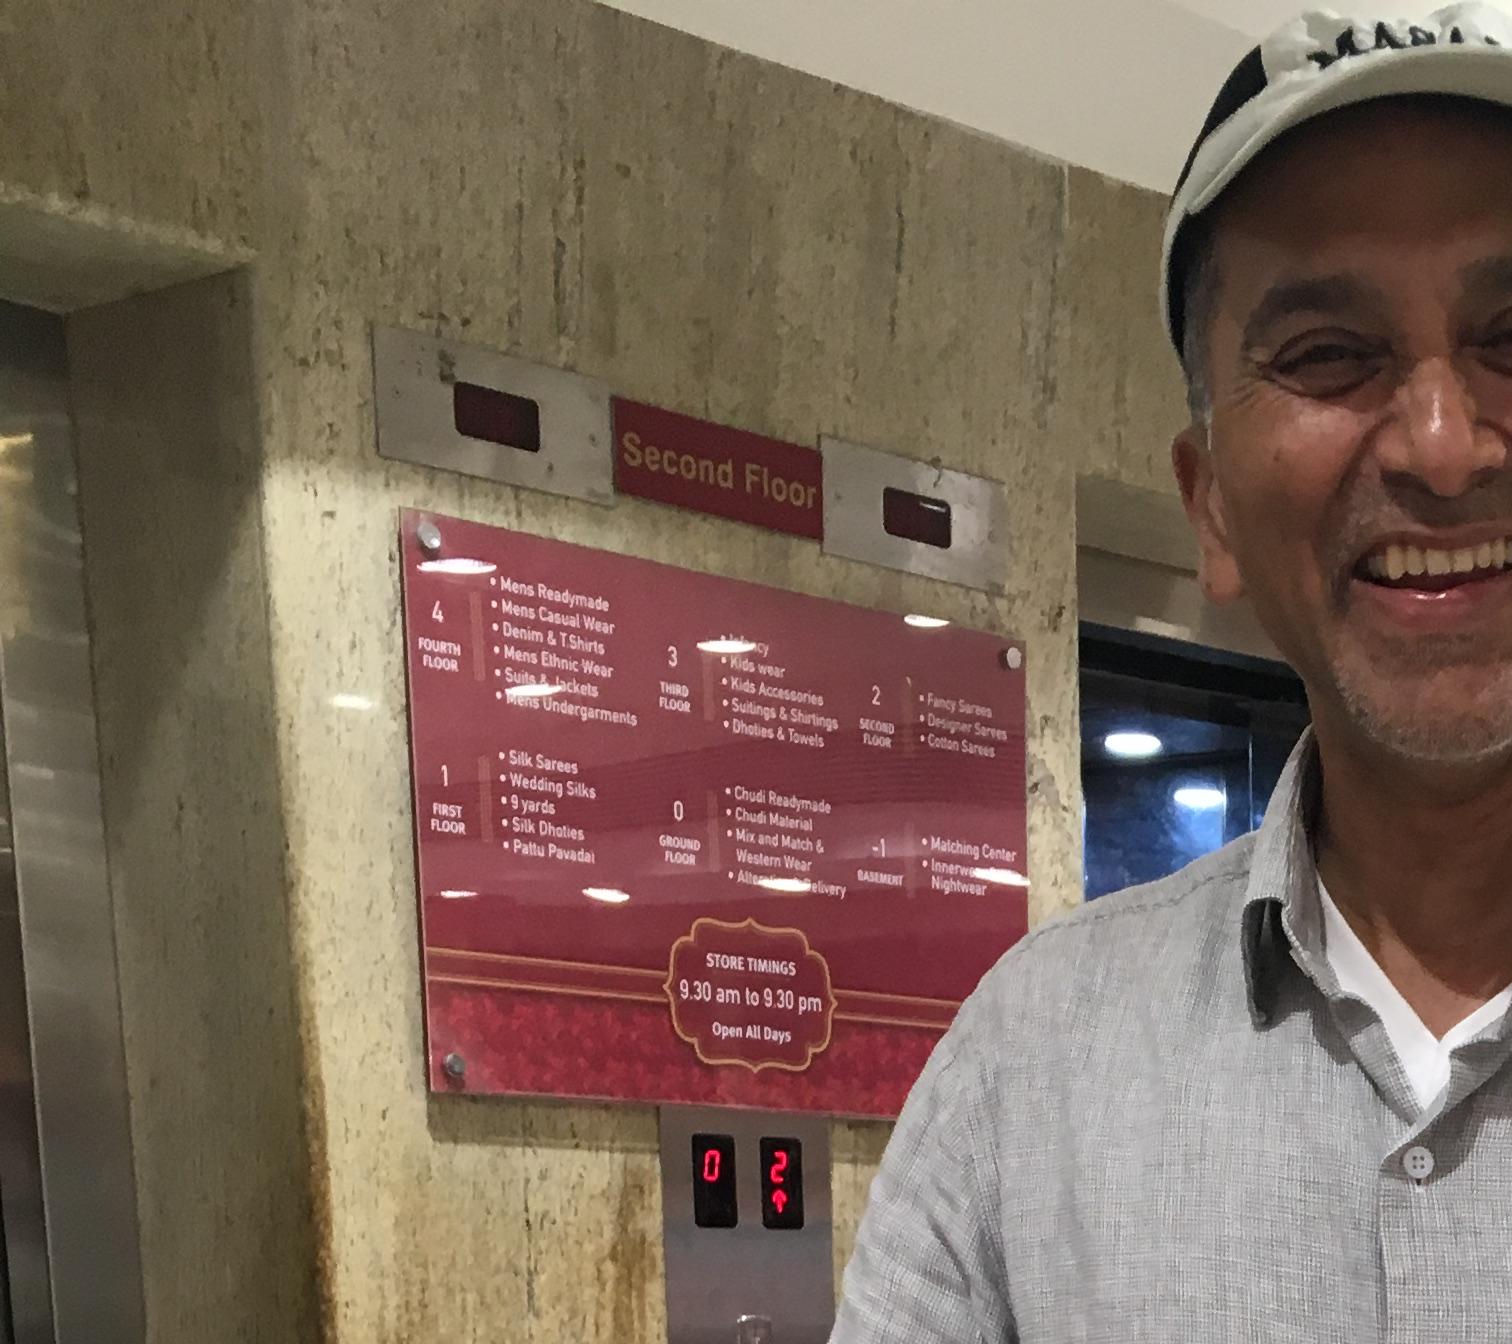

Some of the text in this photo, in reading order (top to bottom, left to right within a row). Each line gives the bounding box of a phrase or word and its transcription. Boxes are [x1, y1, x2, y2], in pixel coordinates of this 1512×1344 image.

[623, 432, 816, 509] Second Floor
[500, 576, 609, 611] Mens Readymade
[432, 600, 444, 622] 4
[501, 600, 615, 634] Mens Casual Wear
[503, 622, 543, 643] Denim
[547, 631, 557, 646] &
[418, 637, 461, 656] FOURTH
[667, 645, 678, 667] 3
[423, 655, 459, 672] FLOOR
[504, 645, 614, 678] Mens Ethnic Wear
[731, 656, 786, 679] Kids wear
[505, 667, 536, 685] Suits
[554, 676, 599, 698] Jackets
[660, 681, 689, 697] THIRD
[731, 677, 824, 706] Kids Accessories
[659, 697, 691, 713] FLOOR
[872, 685, 880, 705] 2
[928, 692, 992, 718] Fancy Sarees
[543, 697, 638, 726] Undergarments
[732, 698, 838, 732] Suitings & Shirtings
[733, 719, 825, 748] Dhoties & Towels
[859, 717, 895, 735] SECOND
[974, 722, 1007, 741] Sarees
[863, 732, 892, 748] FLOOR
[928, 733, 995, 758] Cotton Sarees
[509, 750, 578, 774] Silk Sarees
[441, 765, 448, 787] 1
[510, 772, 596, 799] Wedding Silks
[432, 803, 463, 818] FIRST
[510, 794, 555, 815] 9 yards
[674, 800, 684, 822] 0
[735, 786, 831, 814] Chudi Readymade
[431, 819, 466, 835] FLOOR
[512, 817, 584, 841] Silk Dhoties
[735, 807, 812, 831] Chudi Material
[513, 839, 595, 864] Pattu Pavadai
[659, 834, 701, 852] GROUND
[736, 828, 824, 853] Mix and Match &
[931, 836, 1016, 862] Matching Center
[665, 851, 696, 866] FLOOR
[736, 849, 812, 871] Western Wear
[857, 869, 904, 886] BASEMENT
[932, 876, 988, 896] Nightwear
[706, 953, 796, 976] STORE TIMINGS
[680, 979, 822, 1015] 9.30 am to 9.30 pm
[712, 1022, 791, 1045] Open All Days
[704, 1150, 787, 1184] 0 2
